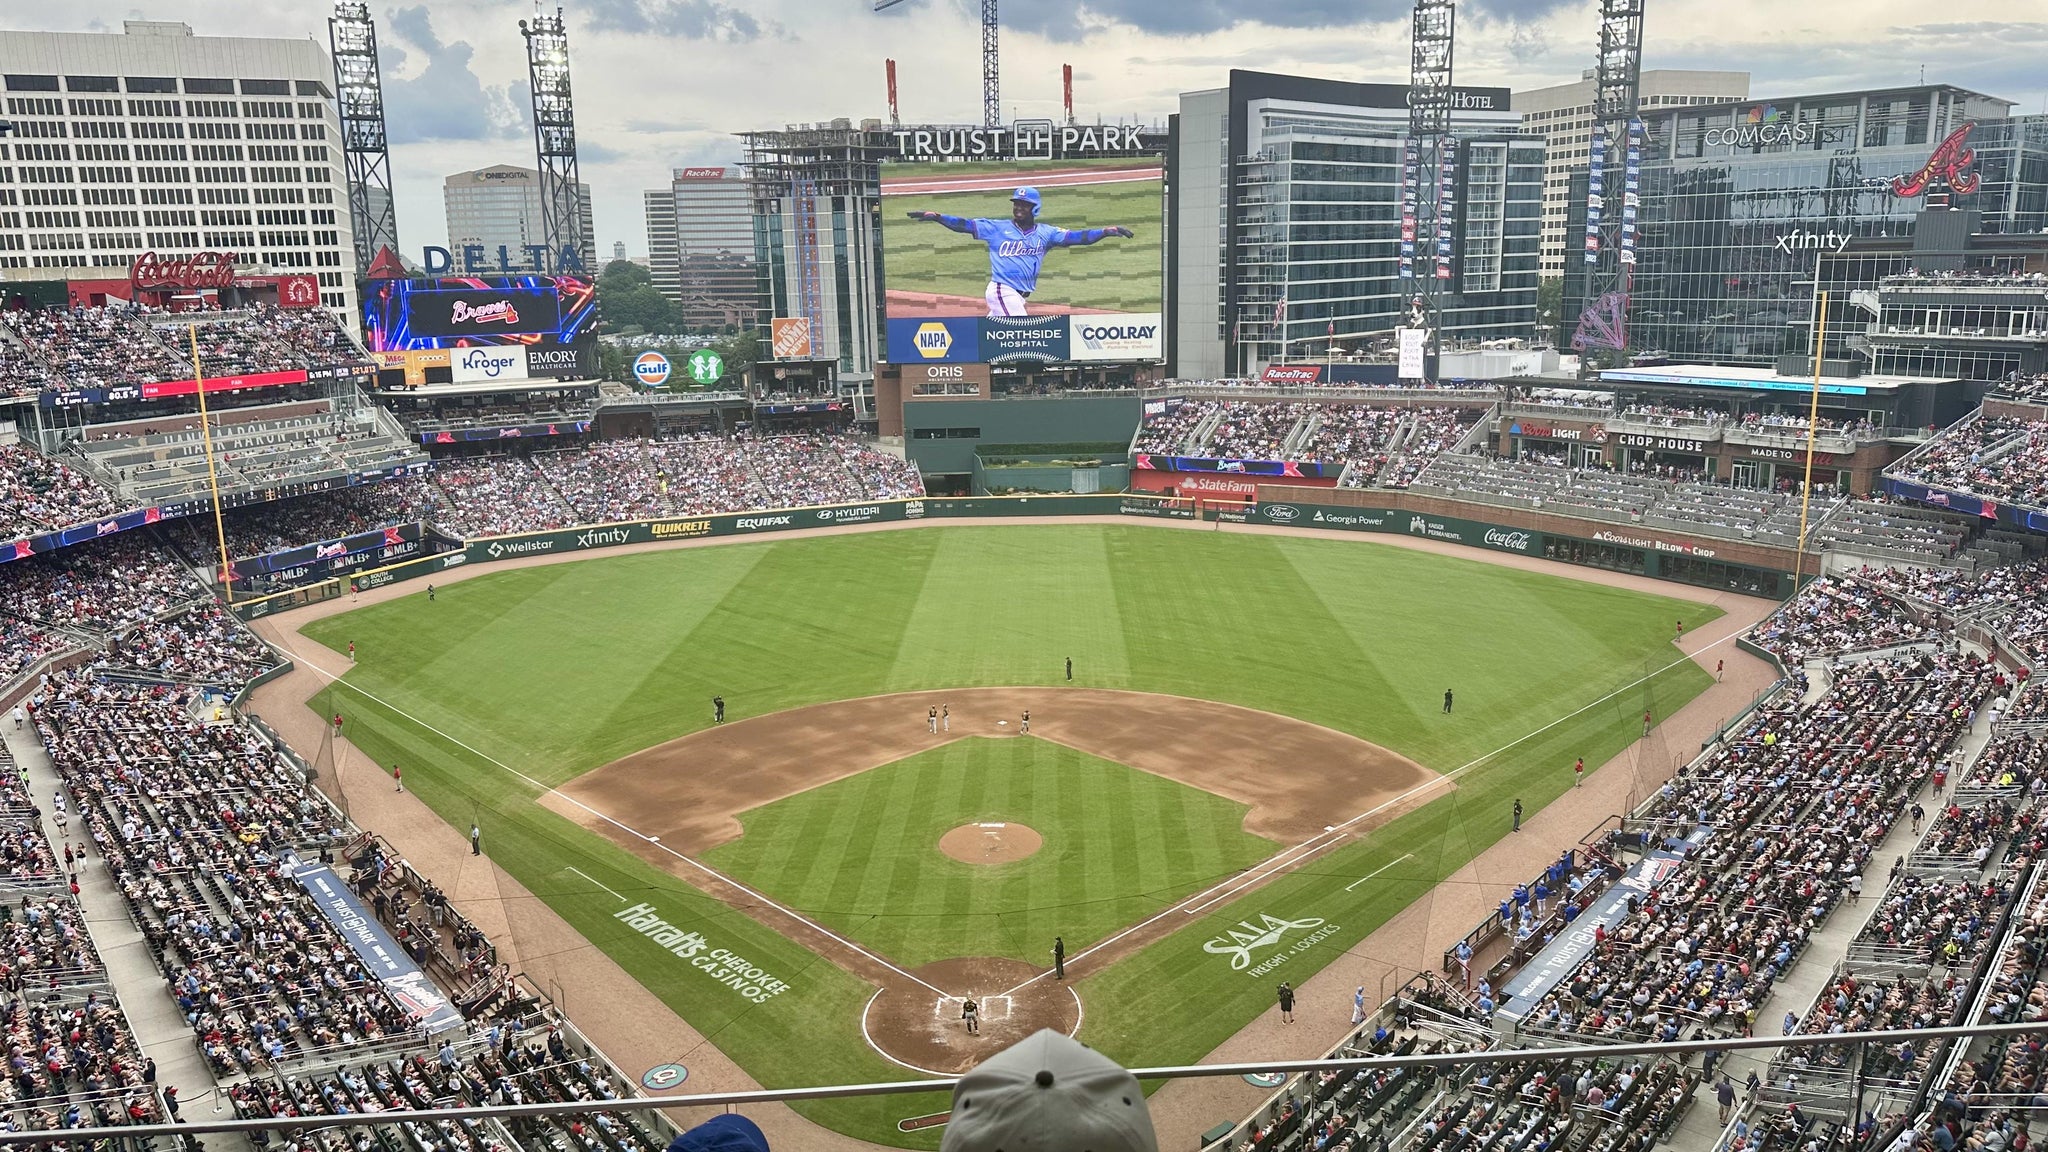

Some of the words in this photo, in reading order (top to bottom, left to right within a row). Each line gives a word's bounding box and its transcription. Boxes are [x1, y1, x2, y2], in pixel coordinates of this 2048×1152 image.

[893, 128, 1006, 155] TRUIST
[1062, 124, 1145, 151] PARK
[1705, 121, 1821, 147] COMCAST
[1774, 229, 1852, 254] xfinity
[423, 245, 584, 274] DELTA
[451, 300, 508, 324] Braves
[777, 322, 792, 337] THE
[986, 330, 1062, 340] NORTHSIDE
[1083, 326, 1156, 340] COOLRAY
[775, 319, 808, 356] HOME
[789, 333, 809, 356] DEPOT
[920, 331, 947, 348] NAPA
[462, 350, 515, 377] Kroger
[530, 350, 578, 364] EMORY
[636, 363, 667, 375] Gulf
[928, 366, 963, 377] ORIS
[1266, 369, 1313, 379] RaceTrac
[1552, 429, 1581, 439] LIGHT
[1619, 434, 1654, 448] CHOP
[1658, 437, 1703, 452] HOUSE
[1751, 449, 1778, 457] MADE
[836, 507, 880, 518] HYUNDAI
[1269, 506, 1293, 518] Ford
[1326, 514, 1356, 525] Georgia
[1359, 512, 1383, 525] Power
[651, 521, 711, 534] QUIKRETE
[736, 516, 790, 529] EQUIFAX
[577, 528, 630, 548] xfinity
[1428, 530, 1460, 540] PERMANENTE
[394, 542, 418, 555] MLB+
[505, 540, 553, 553] Wellstar
[1603, 531, 1628, 543] Coors
[1628, 539, 1651, 548] LIGHT
[1655, 540, 1683, 553] BELOW
[1692, 547, 1715, 558] CHOP
[344, 553, 370, 567] MB+
[282, 568, 309, 582] MLB+
[370, 571, 388, 579] SOUTH
[370, 575, 394, 584] COLLEGE
[330, 898, 357, 920] TRUIST
[353, 926, 378, 944] PARK
[1247, 953, 1289, 978] FREIGHT
[1294, 924, 1341, 952] LOGISTICS
[1547, 940, 1583, 968] TRUIST
[710, 949, 790, 995] CHEROKEE
[691, 956, 772, 1003] CASINOS
